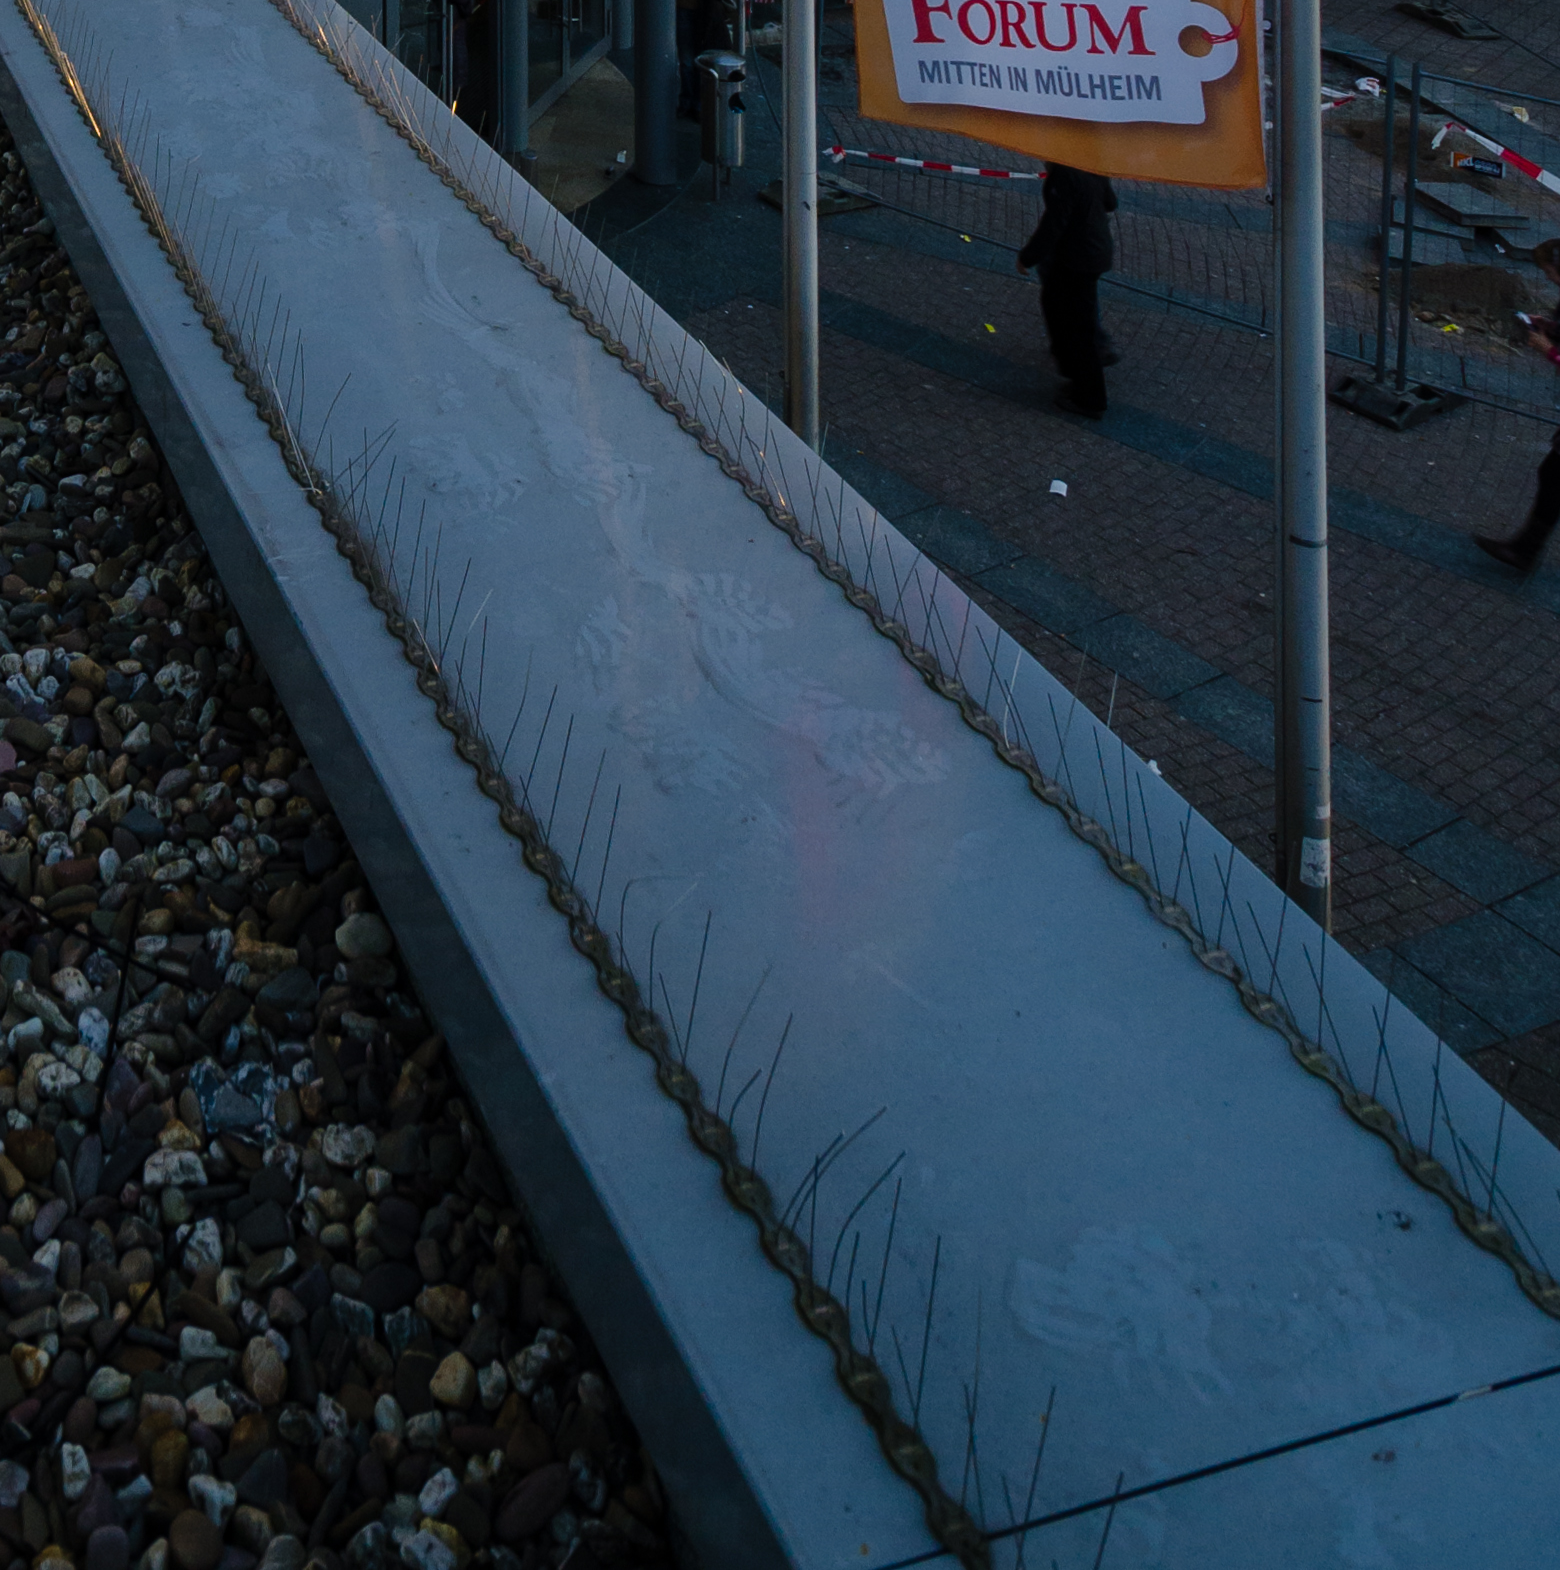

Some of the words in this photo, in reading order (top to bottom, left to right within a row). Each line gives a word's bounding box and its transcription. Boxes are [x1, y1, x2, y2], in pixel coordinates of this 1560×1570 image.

[917, 59, 1003, 89] MITTEN
[1007, 66, 1029, 93] IN
[1034, 65, 1163, 101] MÜLHEIM
